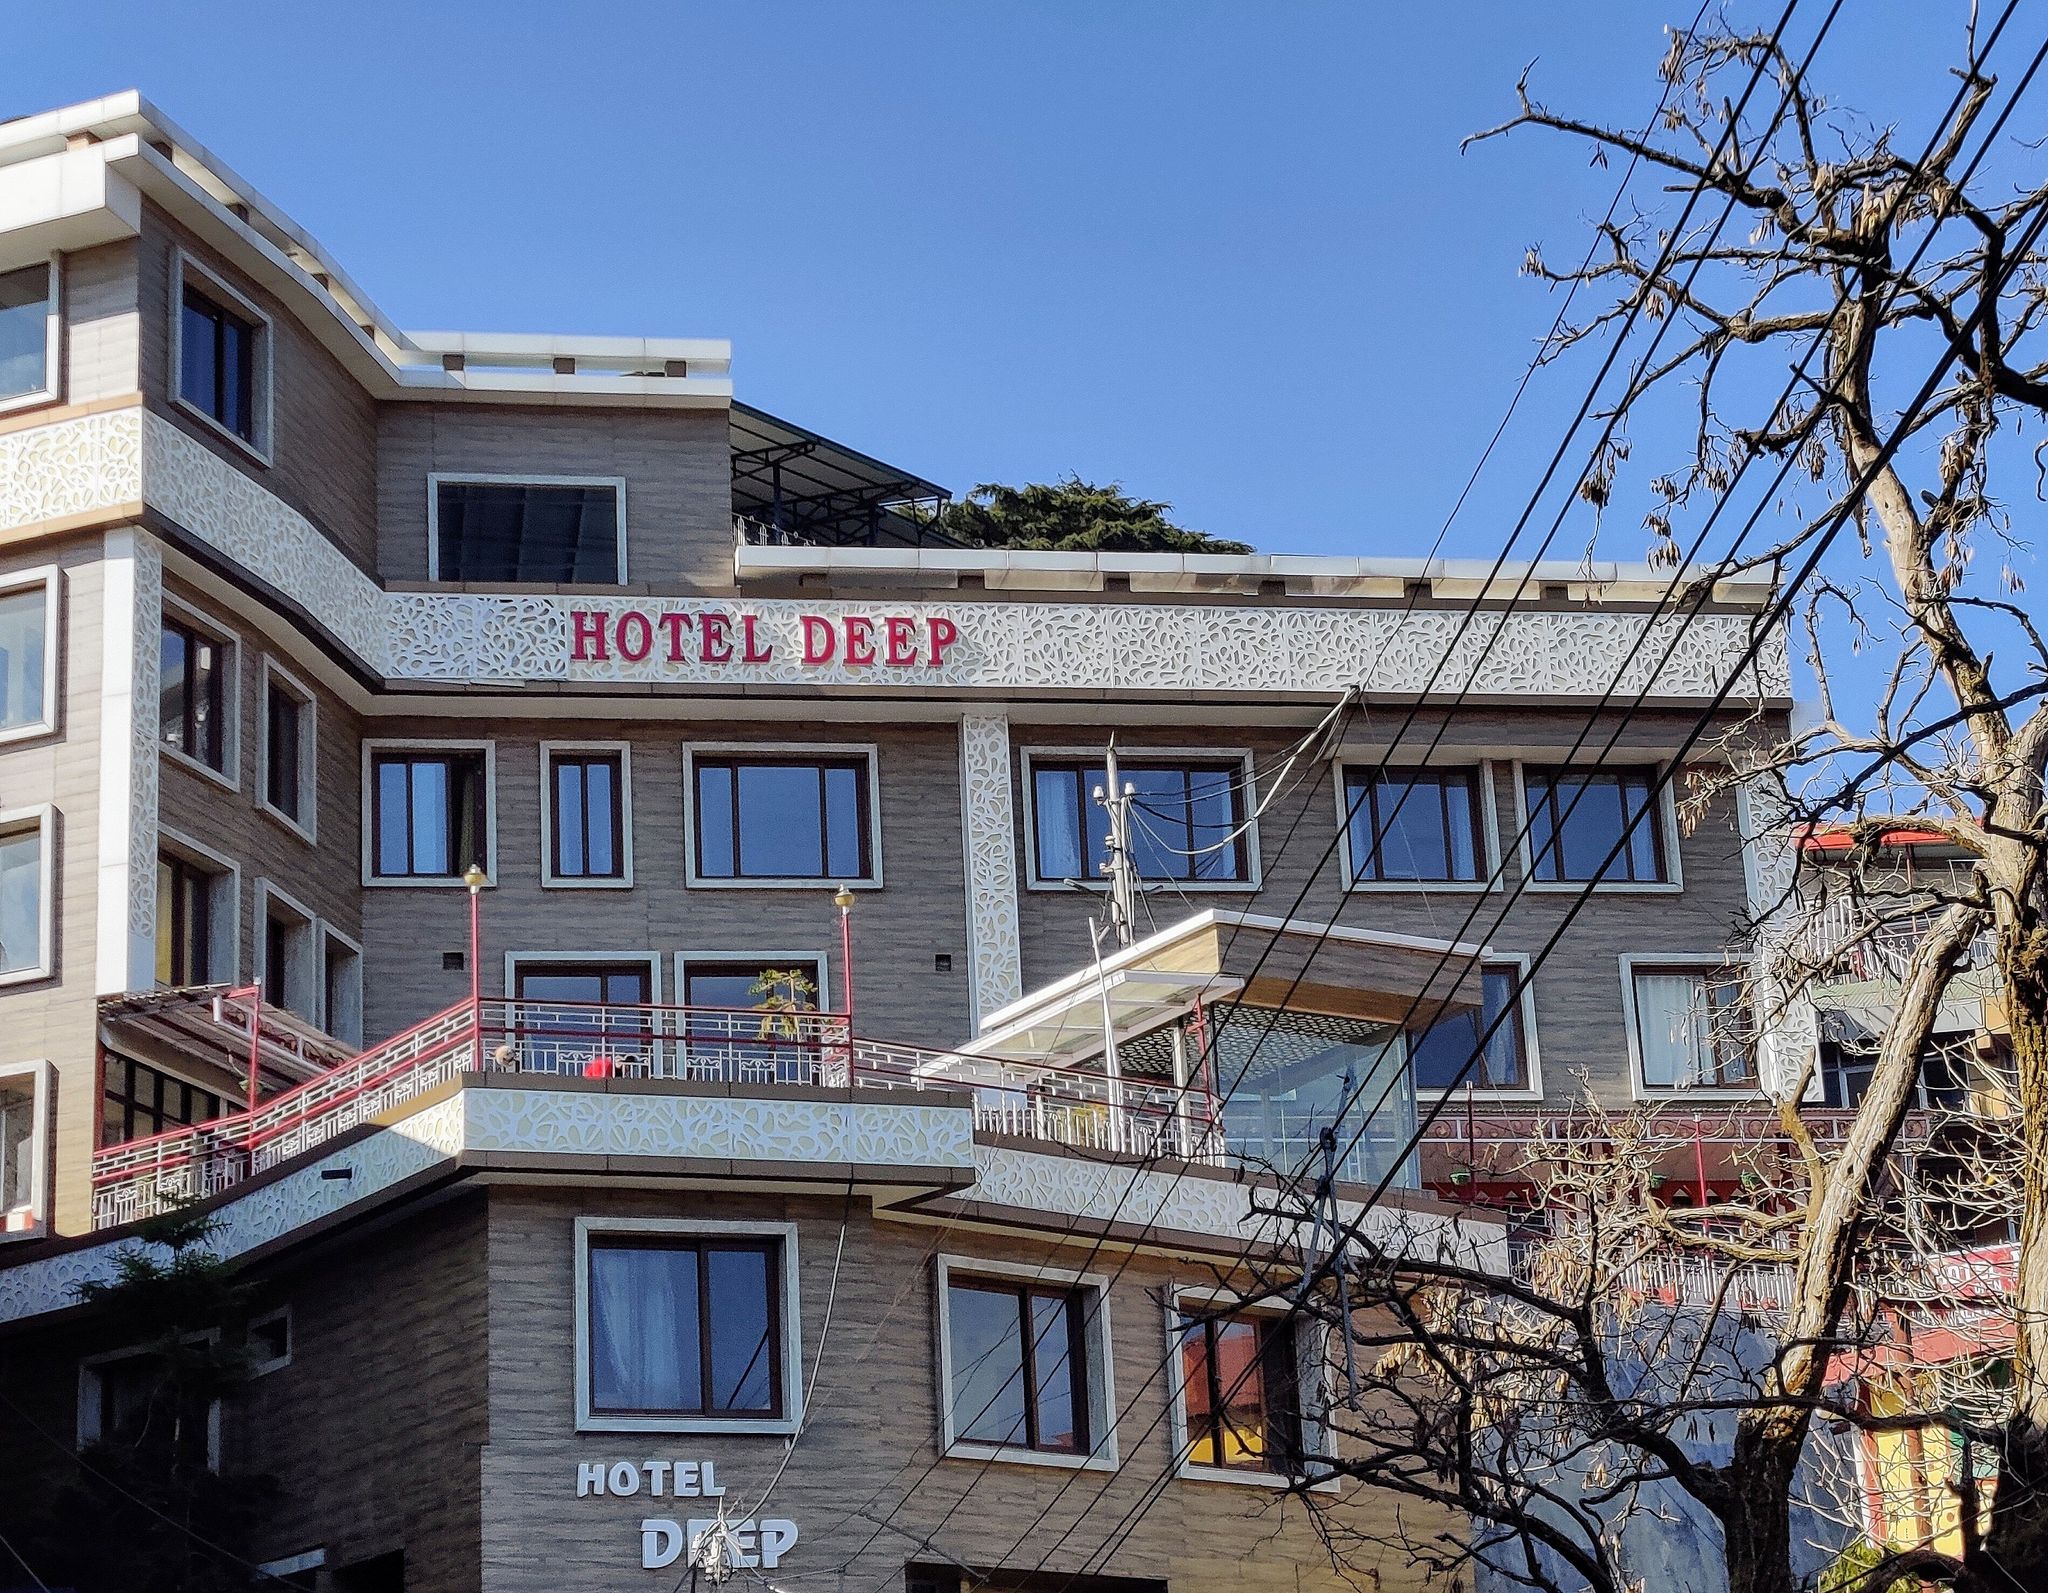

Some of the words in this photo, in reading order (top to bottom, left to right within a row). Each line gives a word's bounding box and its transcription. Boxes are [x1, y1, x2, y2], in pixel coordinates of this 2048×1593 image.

[570, 611, 773, 664] HOTEL
[800, 615, 958, 668] DEEP
[577, 1461, 726, 1498] HOTEL
